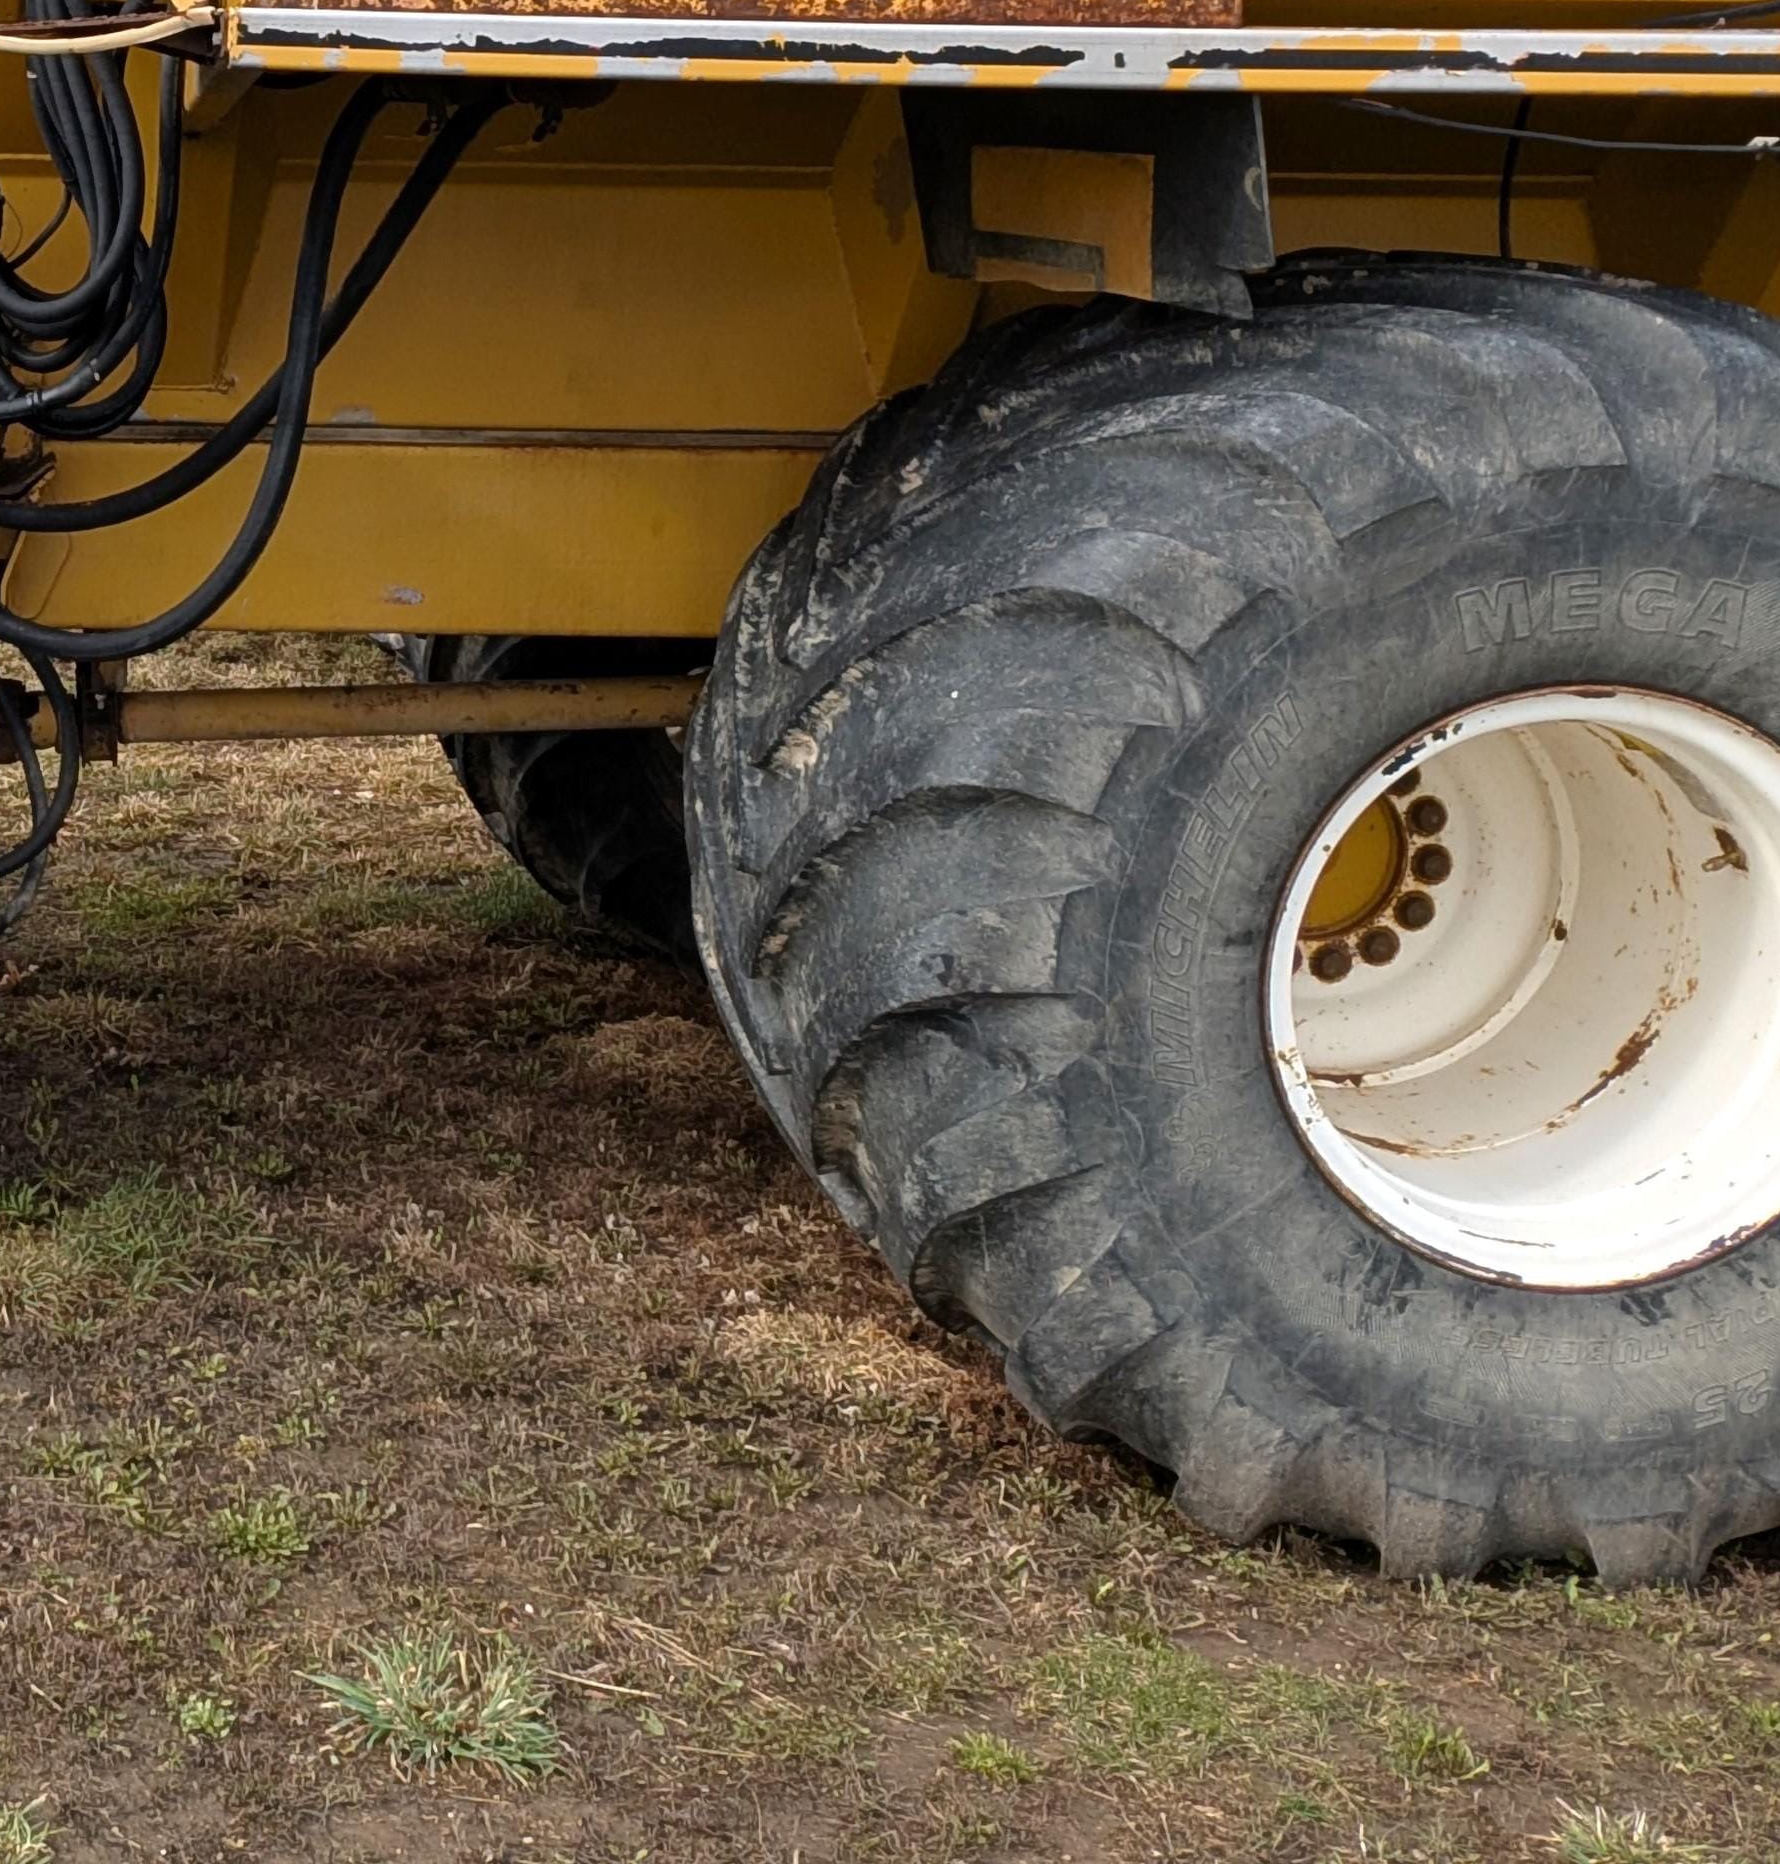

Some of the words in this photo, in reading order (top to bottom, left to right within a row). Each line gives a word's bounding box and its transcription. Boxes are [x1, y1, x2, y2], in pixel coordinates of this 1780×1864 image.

[1455, 567, 1748, 653] MEGA
[1151, 691, 1304, 1087] MICHELIN
[1692, 1370, 1772, 1429] 25
